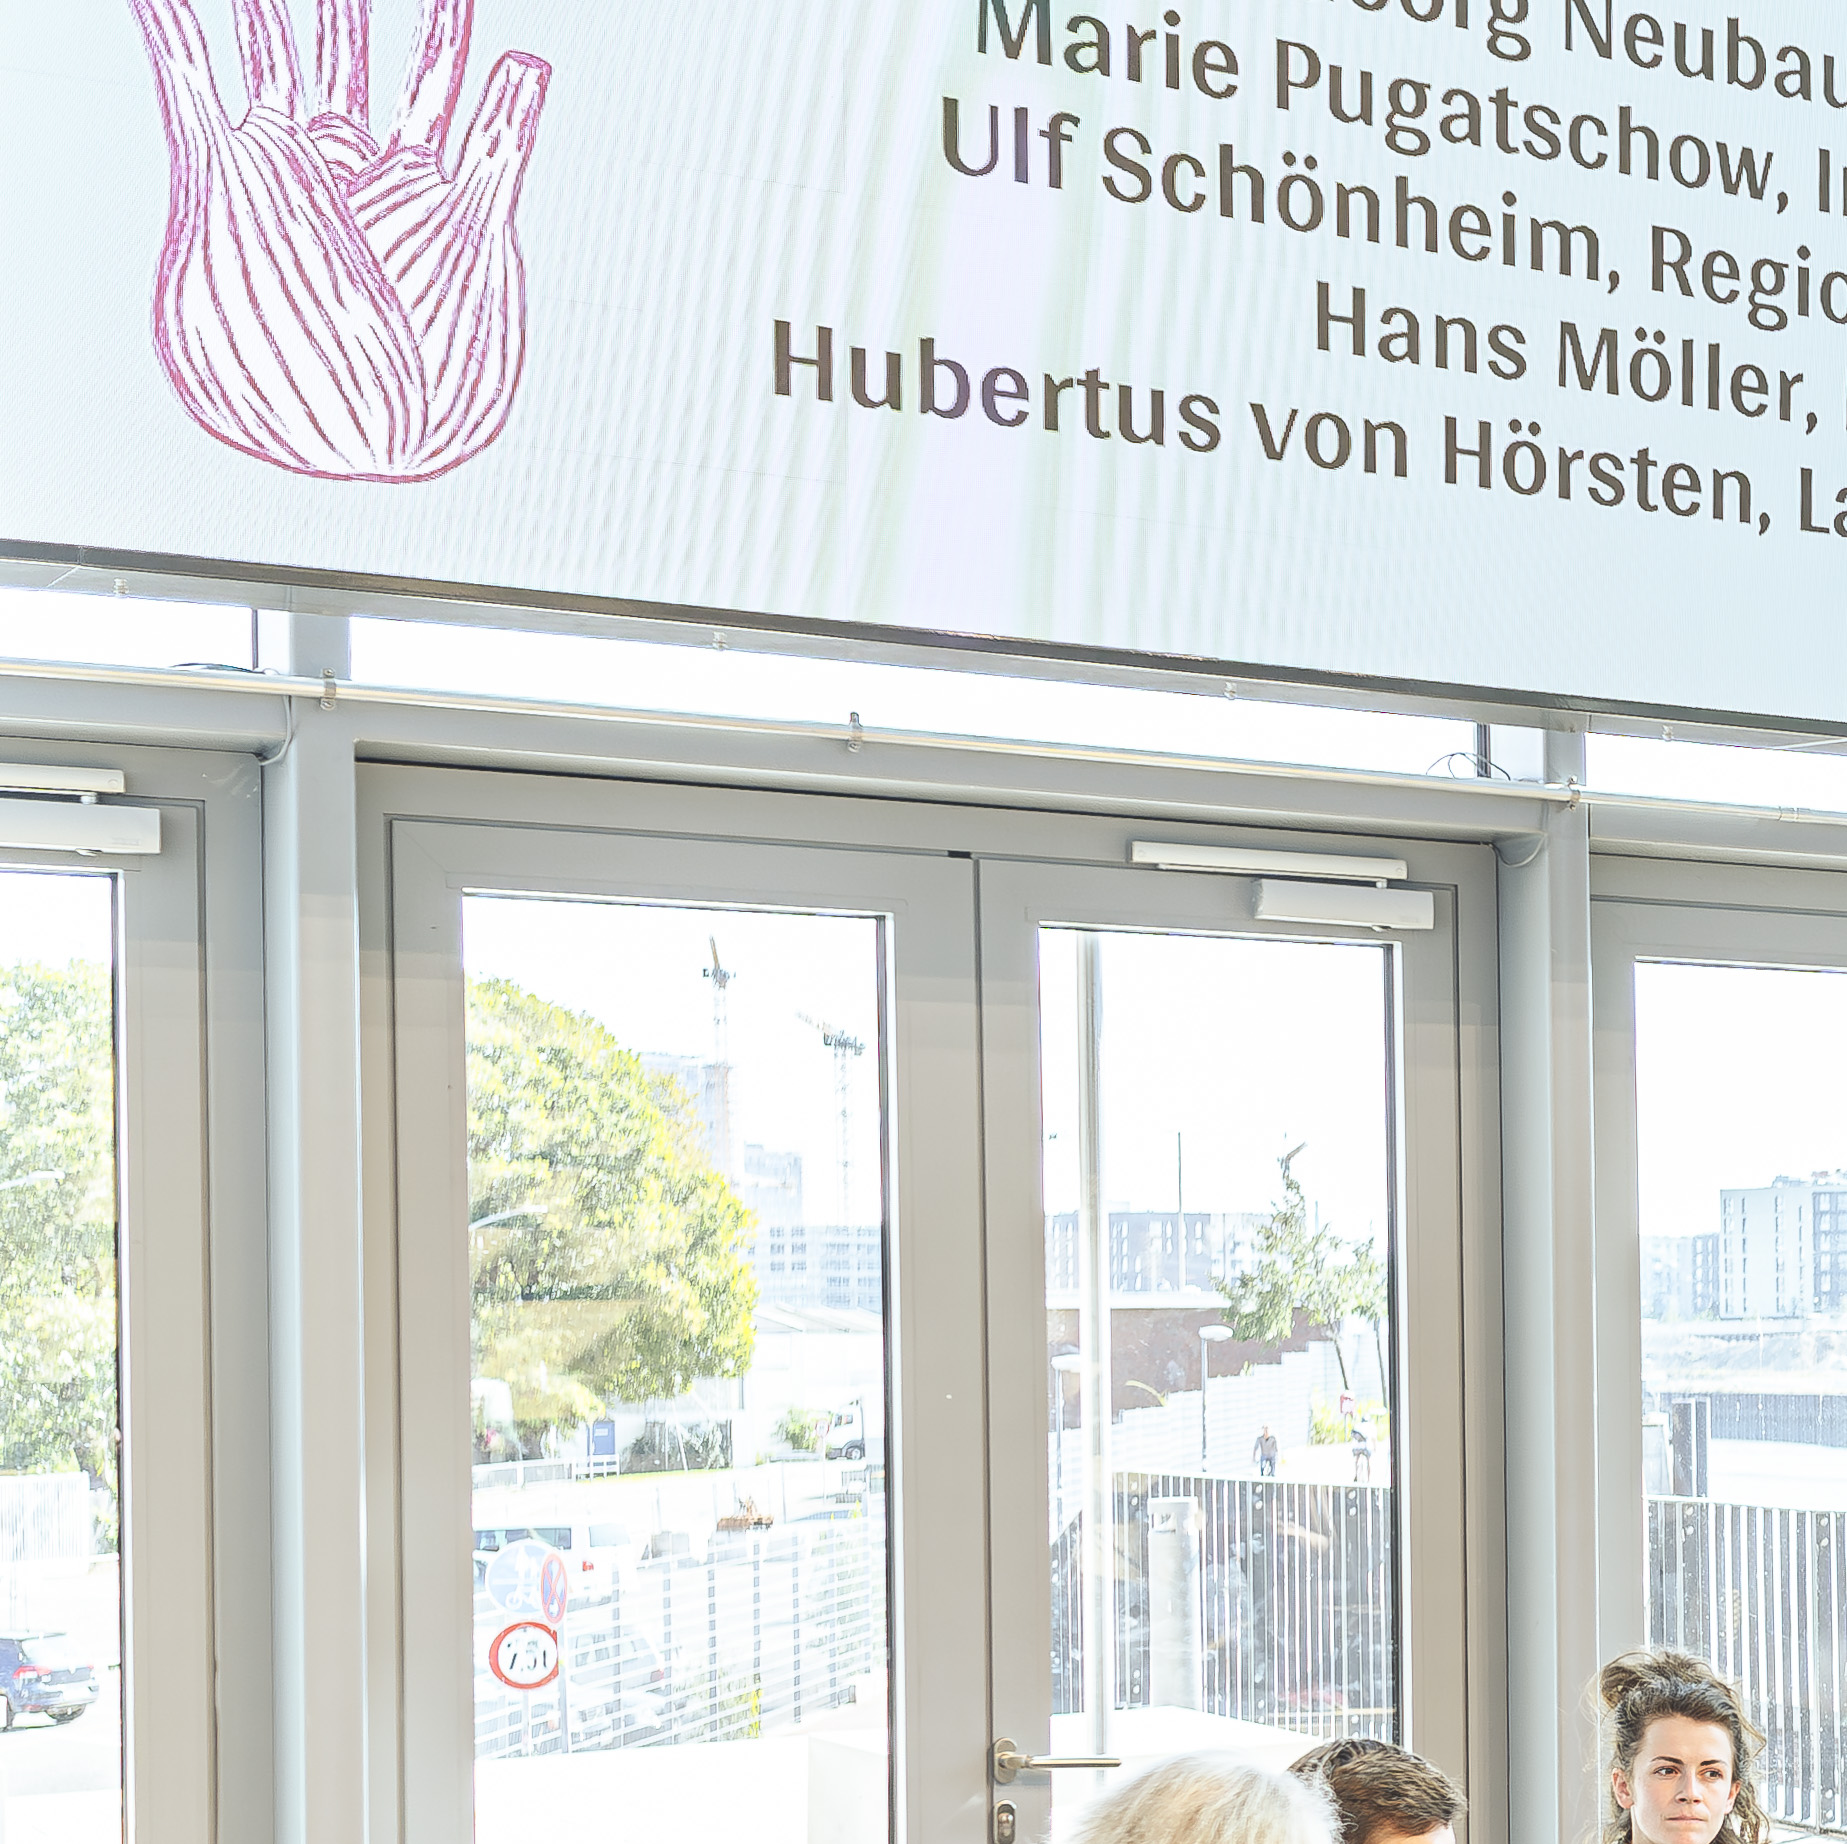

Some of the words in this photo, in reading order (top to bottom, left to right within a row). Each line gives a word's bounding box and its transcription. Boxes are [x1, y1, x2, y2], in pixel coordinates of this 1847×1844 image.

[941, 95, 1081, 190] Ulf
[1101, 126, 1620, 295] Schönheim,
[976, 0, 1239, 100] Marie
[1275, 37, 1789, 215] Pugatschow,
[773, 318, 1222, 454] Hubertus
[1248, 401, 1408, 478] von
[1444, 414, 1771, 537] Hörsten,
[1315, 279, 1527, 381] Hans
[1558, 320, 1818, 436] Möller,
